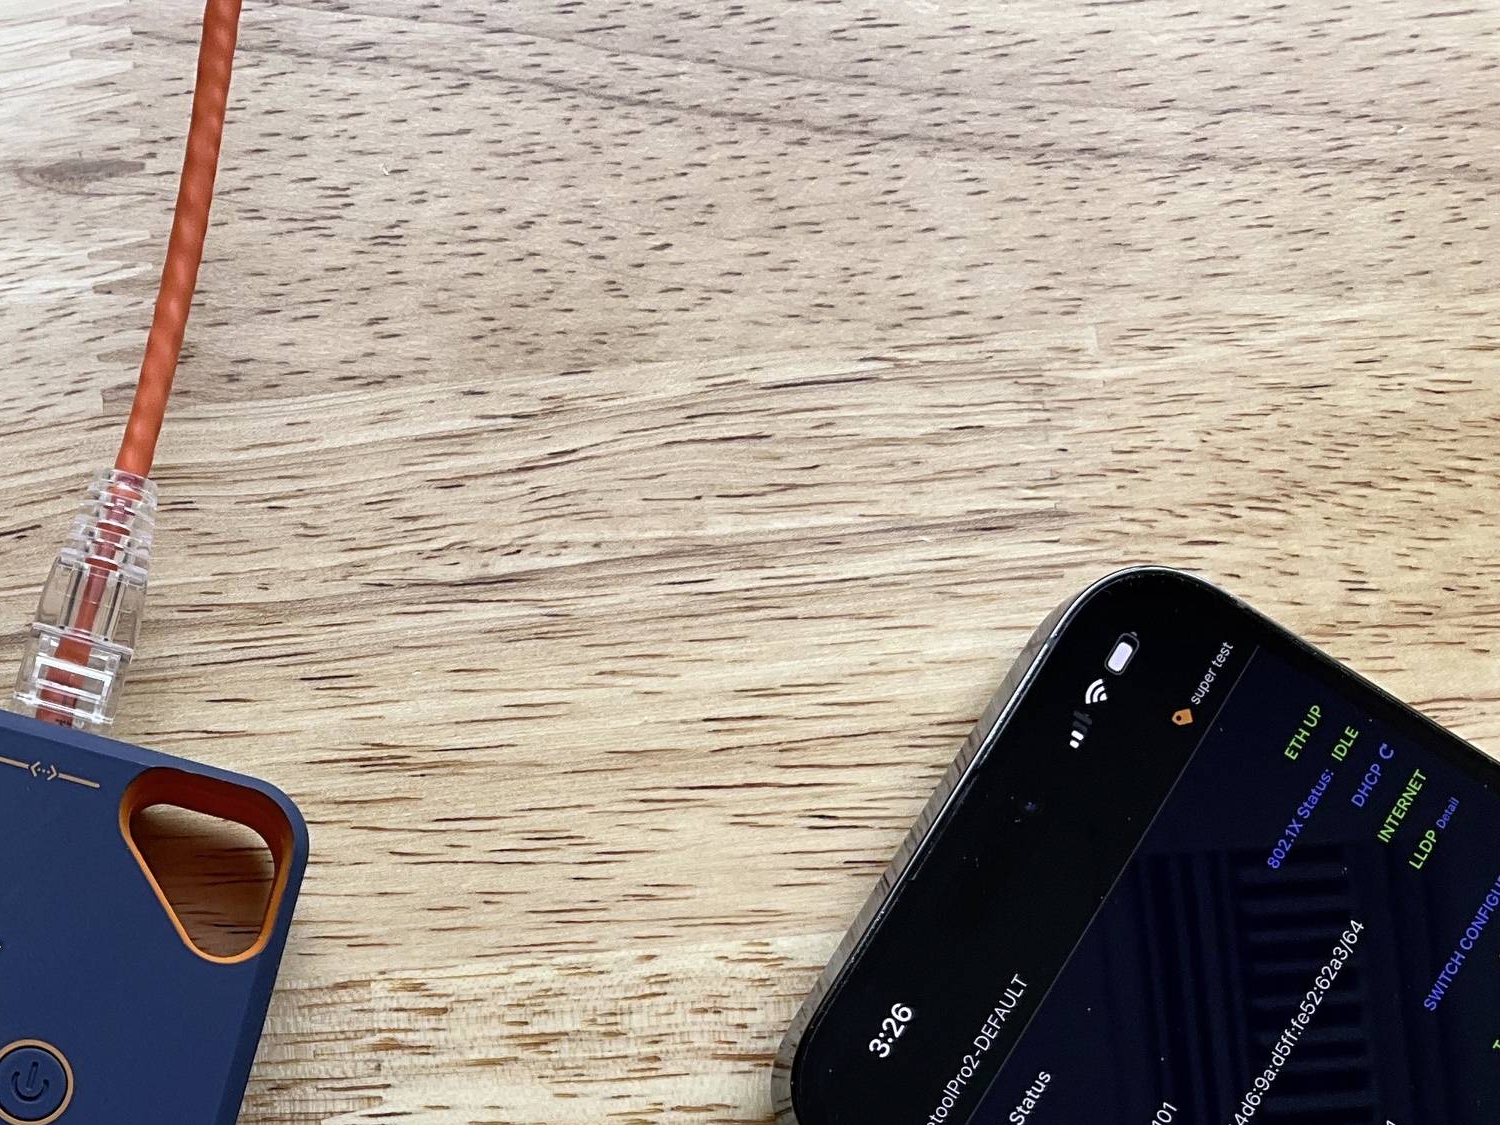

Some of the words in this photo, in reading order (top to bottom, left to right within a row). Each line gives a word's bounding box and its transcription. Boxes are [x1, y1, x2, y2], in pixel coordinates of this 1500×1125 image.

[1190, 667, 1217, 705] super
[1211, 641, 1234, 668] test
[1284, 728, 1311, 761] ETH
[1303, 705, 1322, 728] UP
[1267, 818, 1304, 869] 802.1X
[1296, 768, 1332, 819] Status:
[1331, 725, 1359, 762] IDLE
[1350, 763, 1381, 808] DHCP
[1377, 768, 1427, 843] INTERNET
[1408, 829, 1437, 870] LLDP
[1435, 796, 1460, 830] Detail
[1423, 950, 1466, 1012] SWITCH
[868, 1002, 913, 1058] 3:26
[1009, 1071, 1051, 1125] Status
